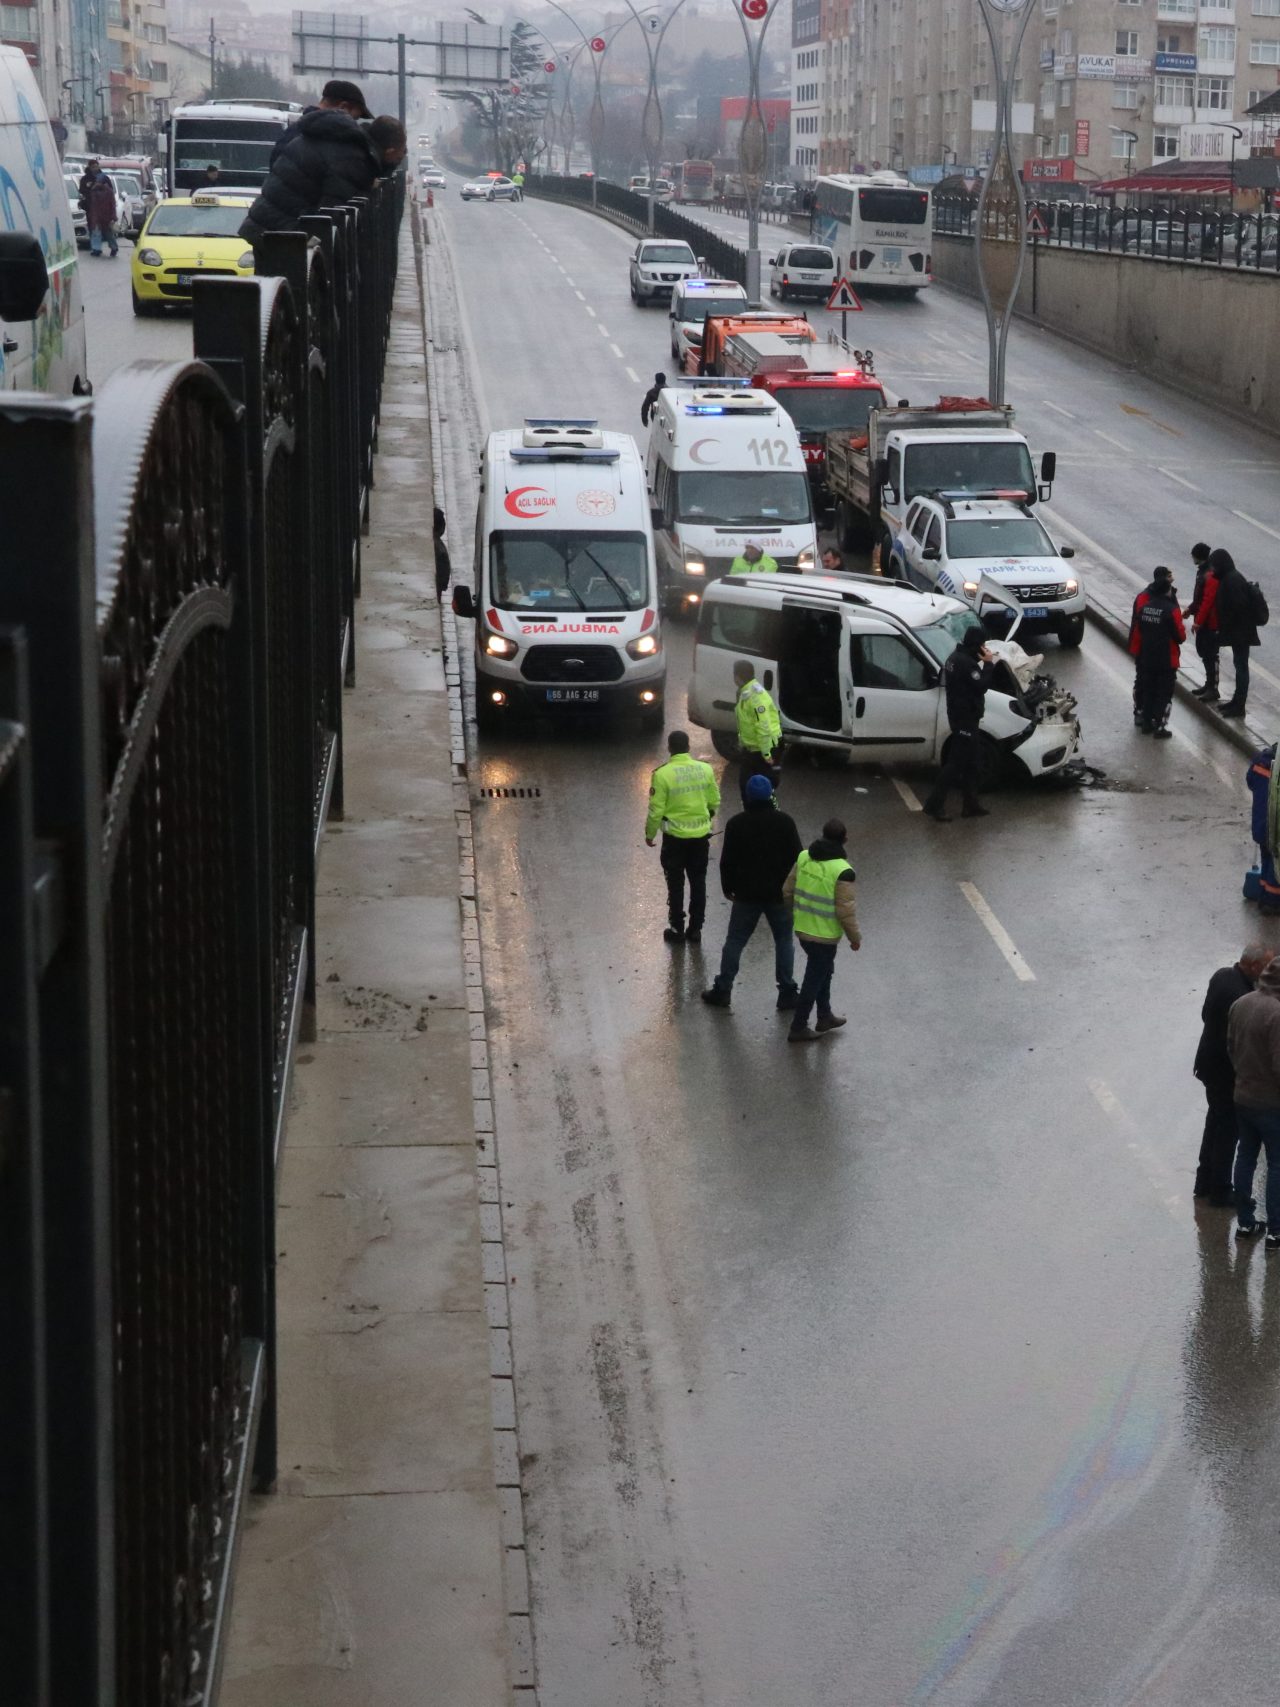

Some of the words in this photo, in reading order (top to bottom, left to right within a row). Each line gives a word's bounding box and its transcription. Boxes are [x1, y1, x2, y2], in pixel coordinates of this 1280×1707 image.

[1080, 57, 1114, 66] AVUKAT
[747, 437, 793, 467] 112
[518, 498, 532, 507] ACİL
[533, 497, 556, 506] SAĞLIK
[552, 690, 562, 699] 66
[565, 690, 580, 699] AAG
